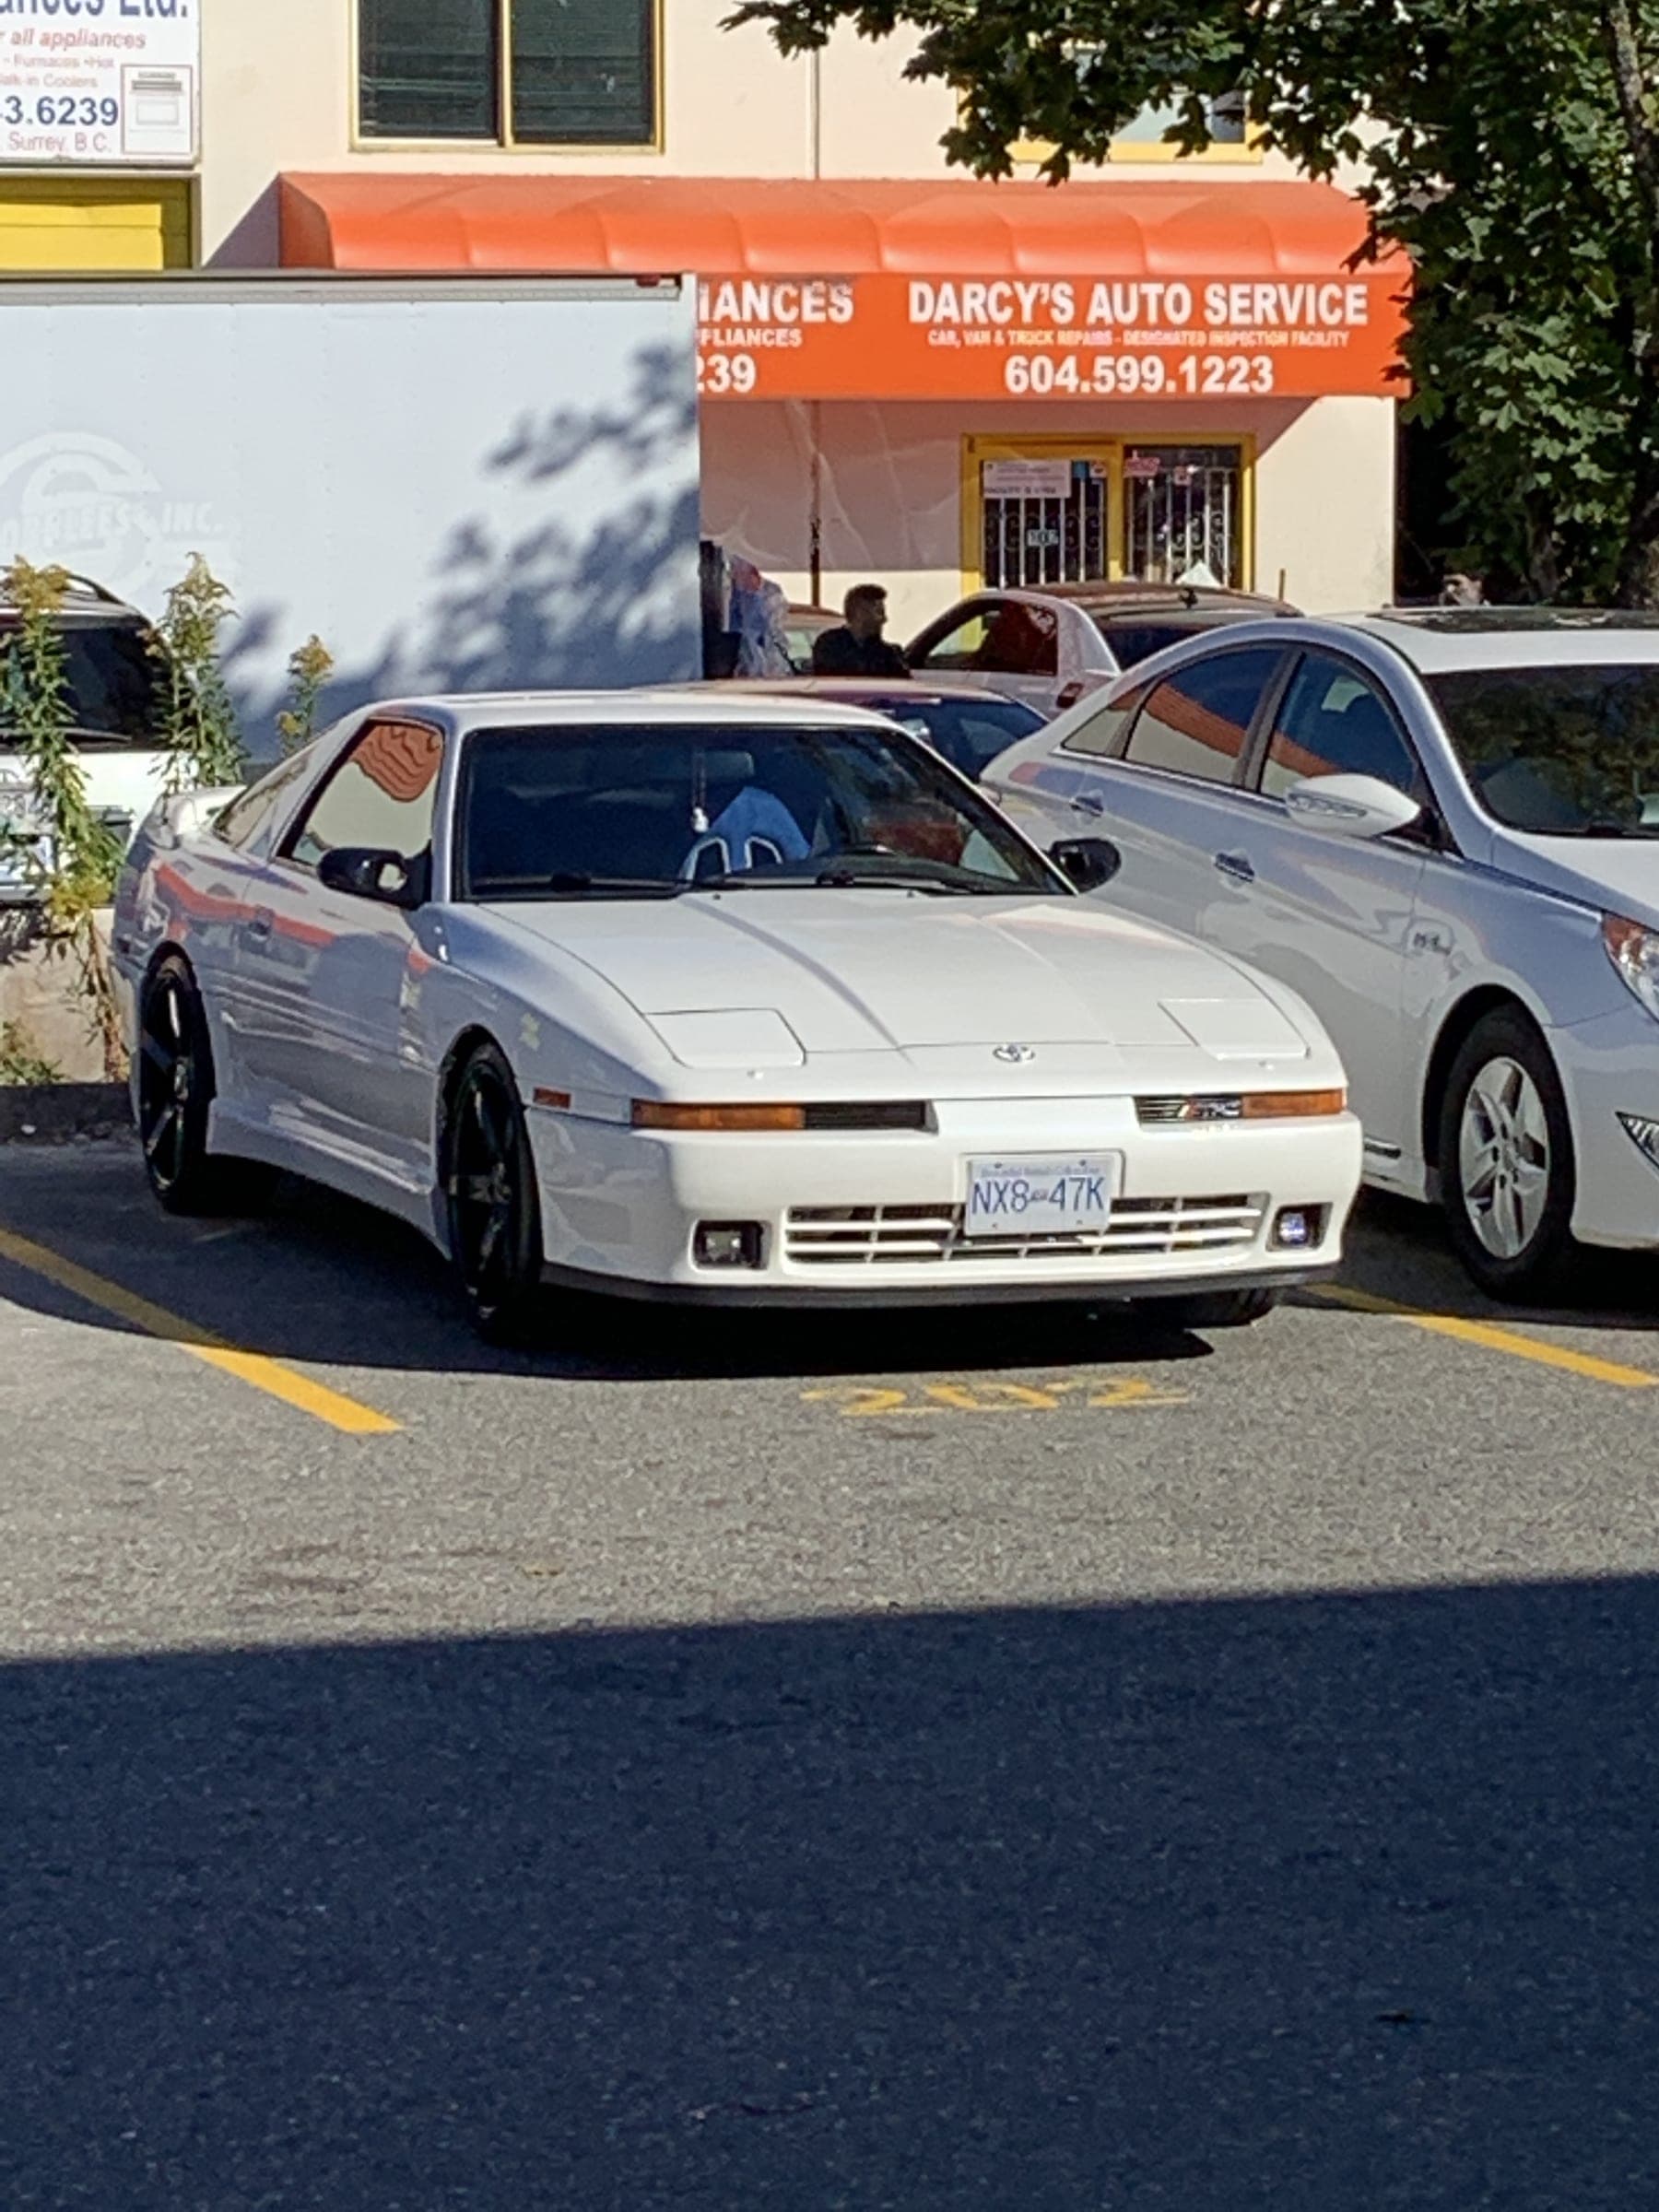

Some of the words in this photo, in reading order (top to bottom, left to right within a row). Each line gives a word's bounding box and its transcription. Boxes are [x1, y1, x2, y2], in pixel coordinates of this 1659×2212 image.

[11, 28, 34, 45] all
[40, 29, 147, 51] appliances
[0, 95, 119, 126] 3.6239
[909, 281, 1075, 324] DARCY'S
[1086, 283, 1193, 324] AUTO
[1204, 283, 1369, 325] SERVICE
[697, 328, 803, 347] PLIANCES
[1005, 355, 1274, 394] 604.599.1223
[971, 1178, 1030, 1215] NX8
[1048, 1176, 1105, 1211] 47K
